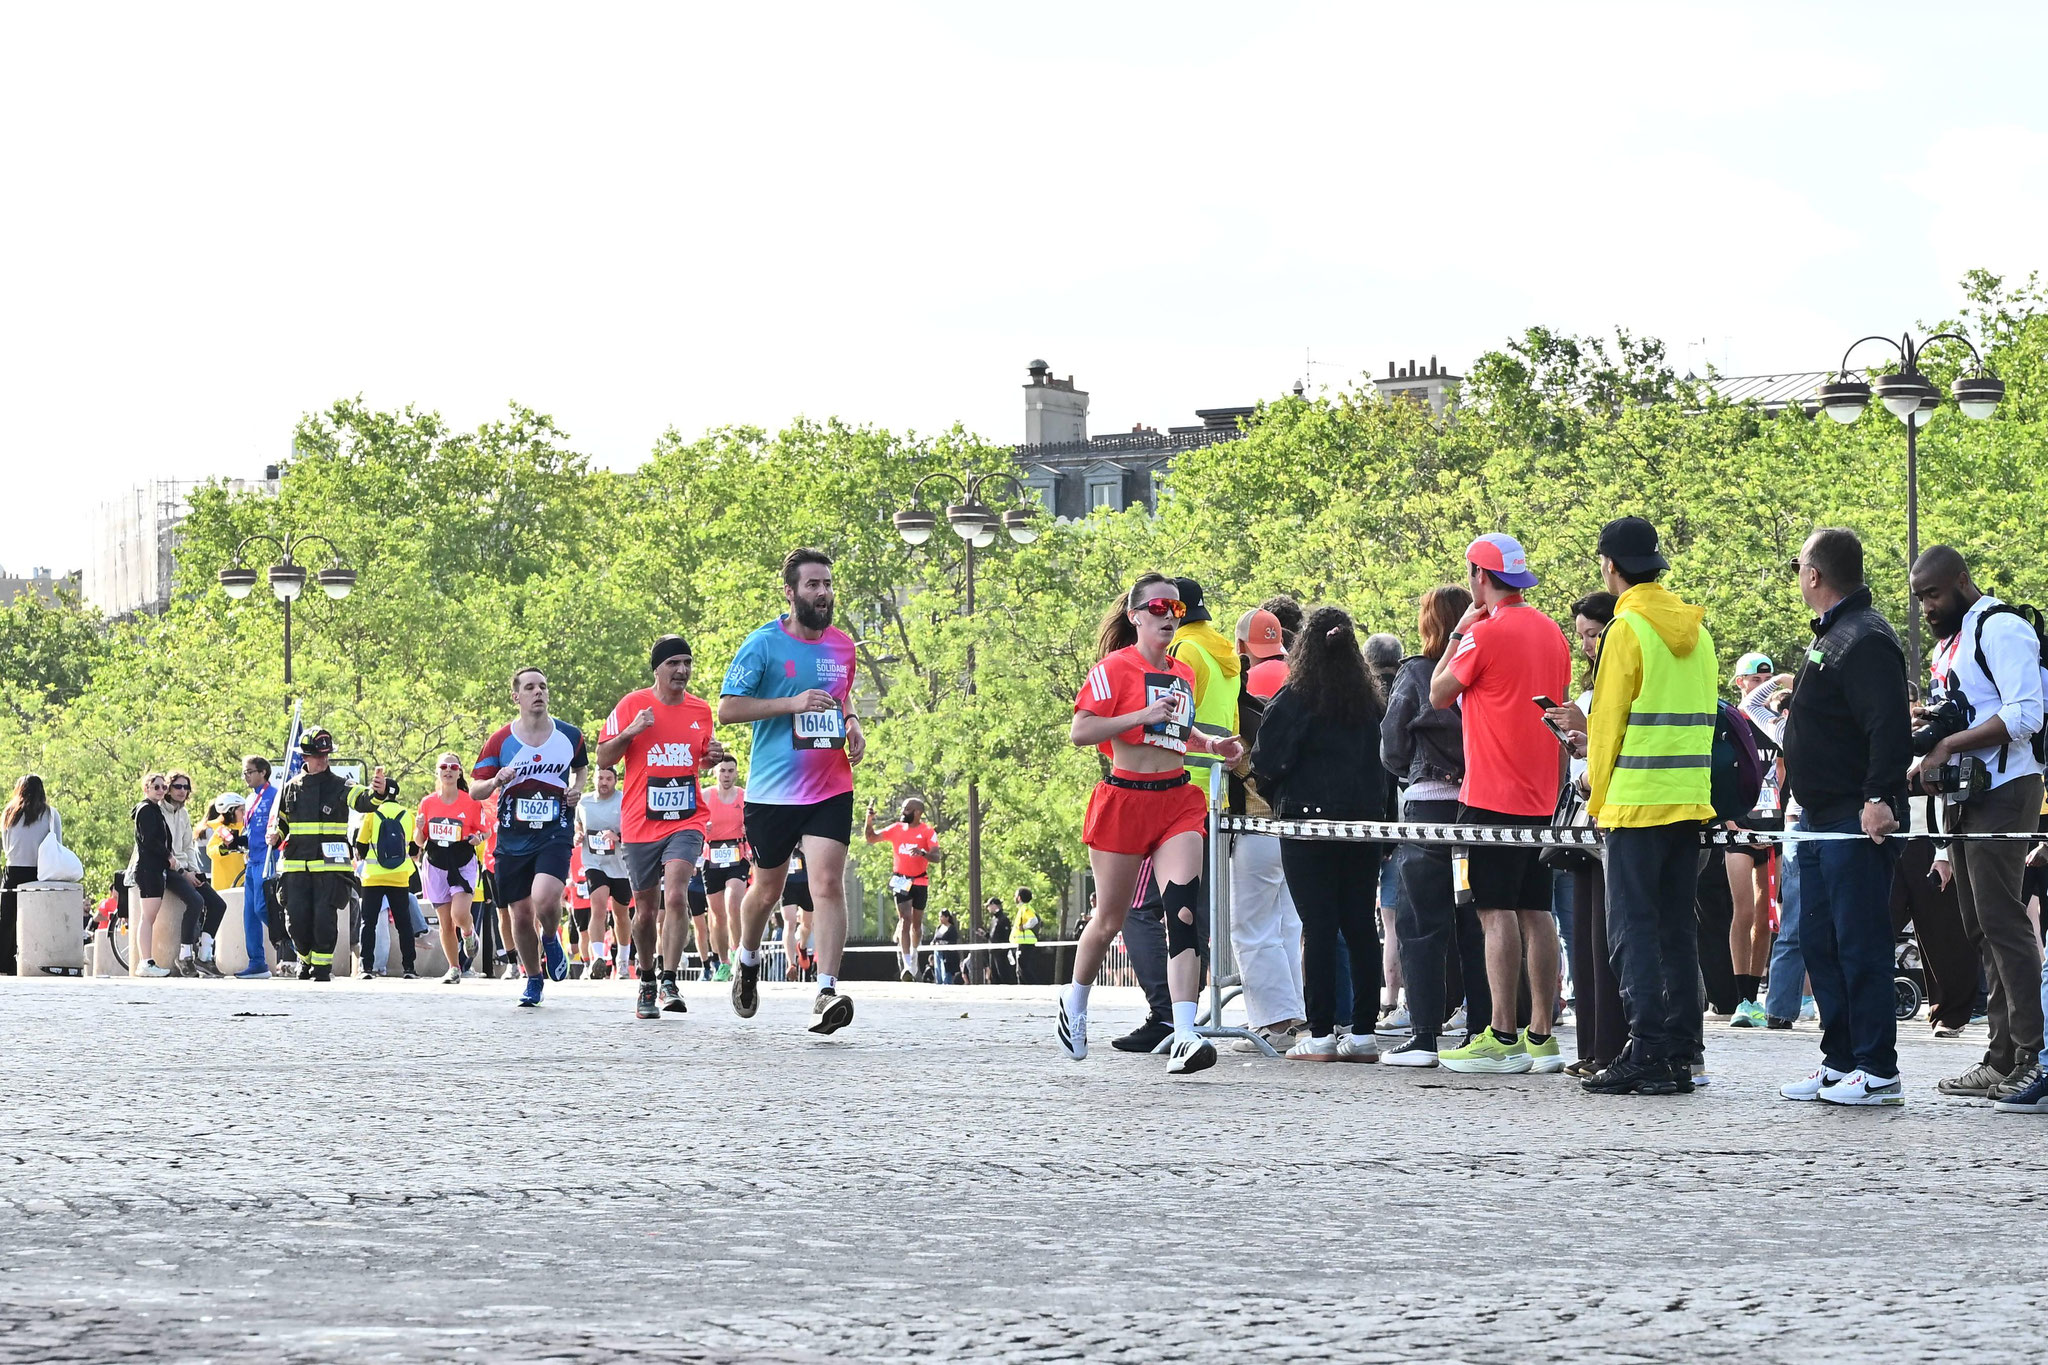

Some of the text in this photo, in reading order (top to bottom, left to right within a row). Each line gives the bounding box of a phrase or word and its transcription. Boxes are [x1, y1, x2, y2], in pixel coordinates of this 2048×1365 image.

[1265, 627, 1277, 640] 36
[816, 664, 847, 674] SOLIDAIRE
[800, 714, 834, 732] 16146
[664, 743, 691, 755] 10K
[647, 754, 693, 767] PARIS
[514, 763, 565, 778] TAIWAN
[653, 791, 685, 807] 16737
[521, 800, 549, 815] 13626
[433, 825, 453, 836] 11344
[326, 843, 345, 853] 7094
[714, 850, 732, 859] 8059
